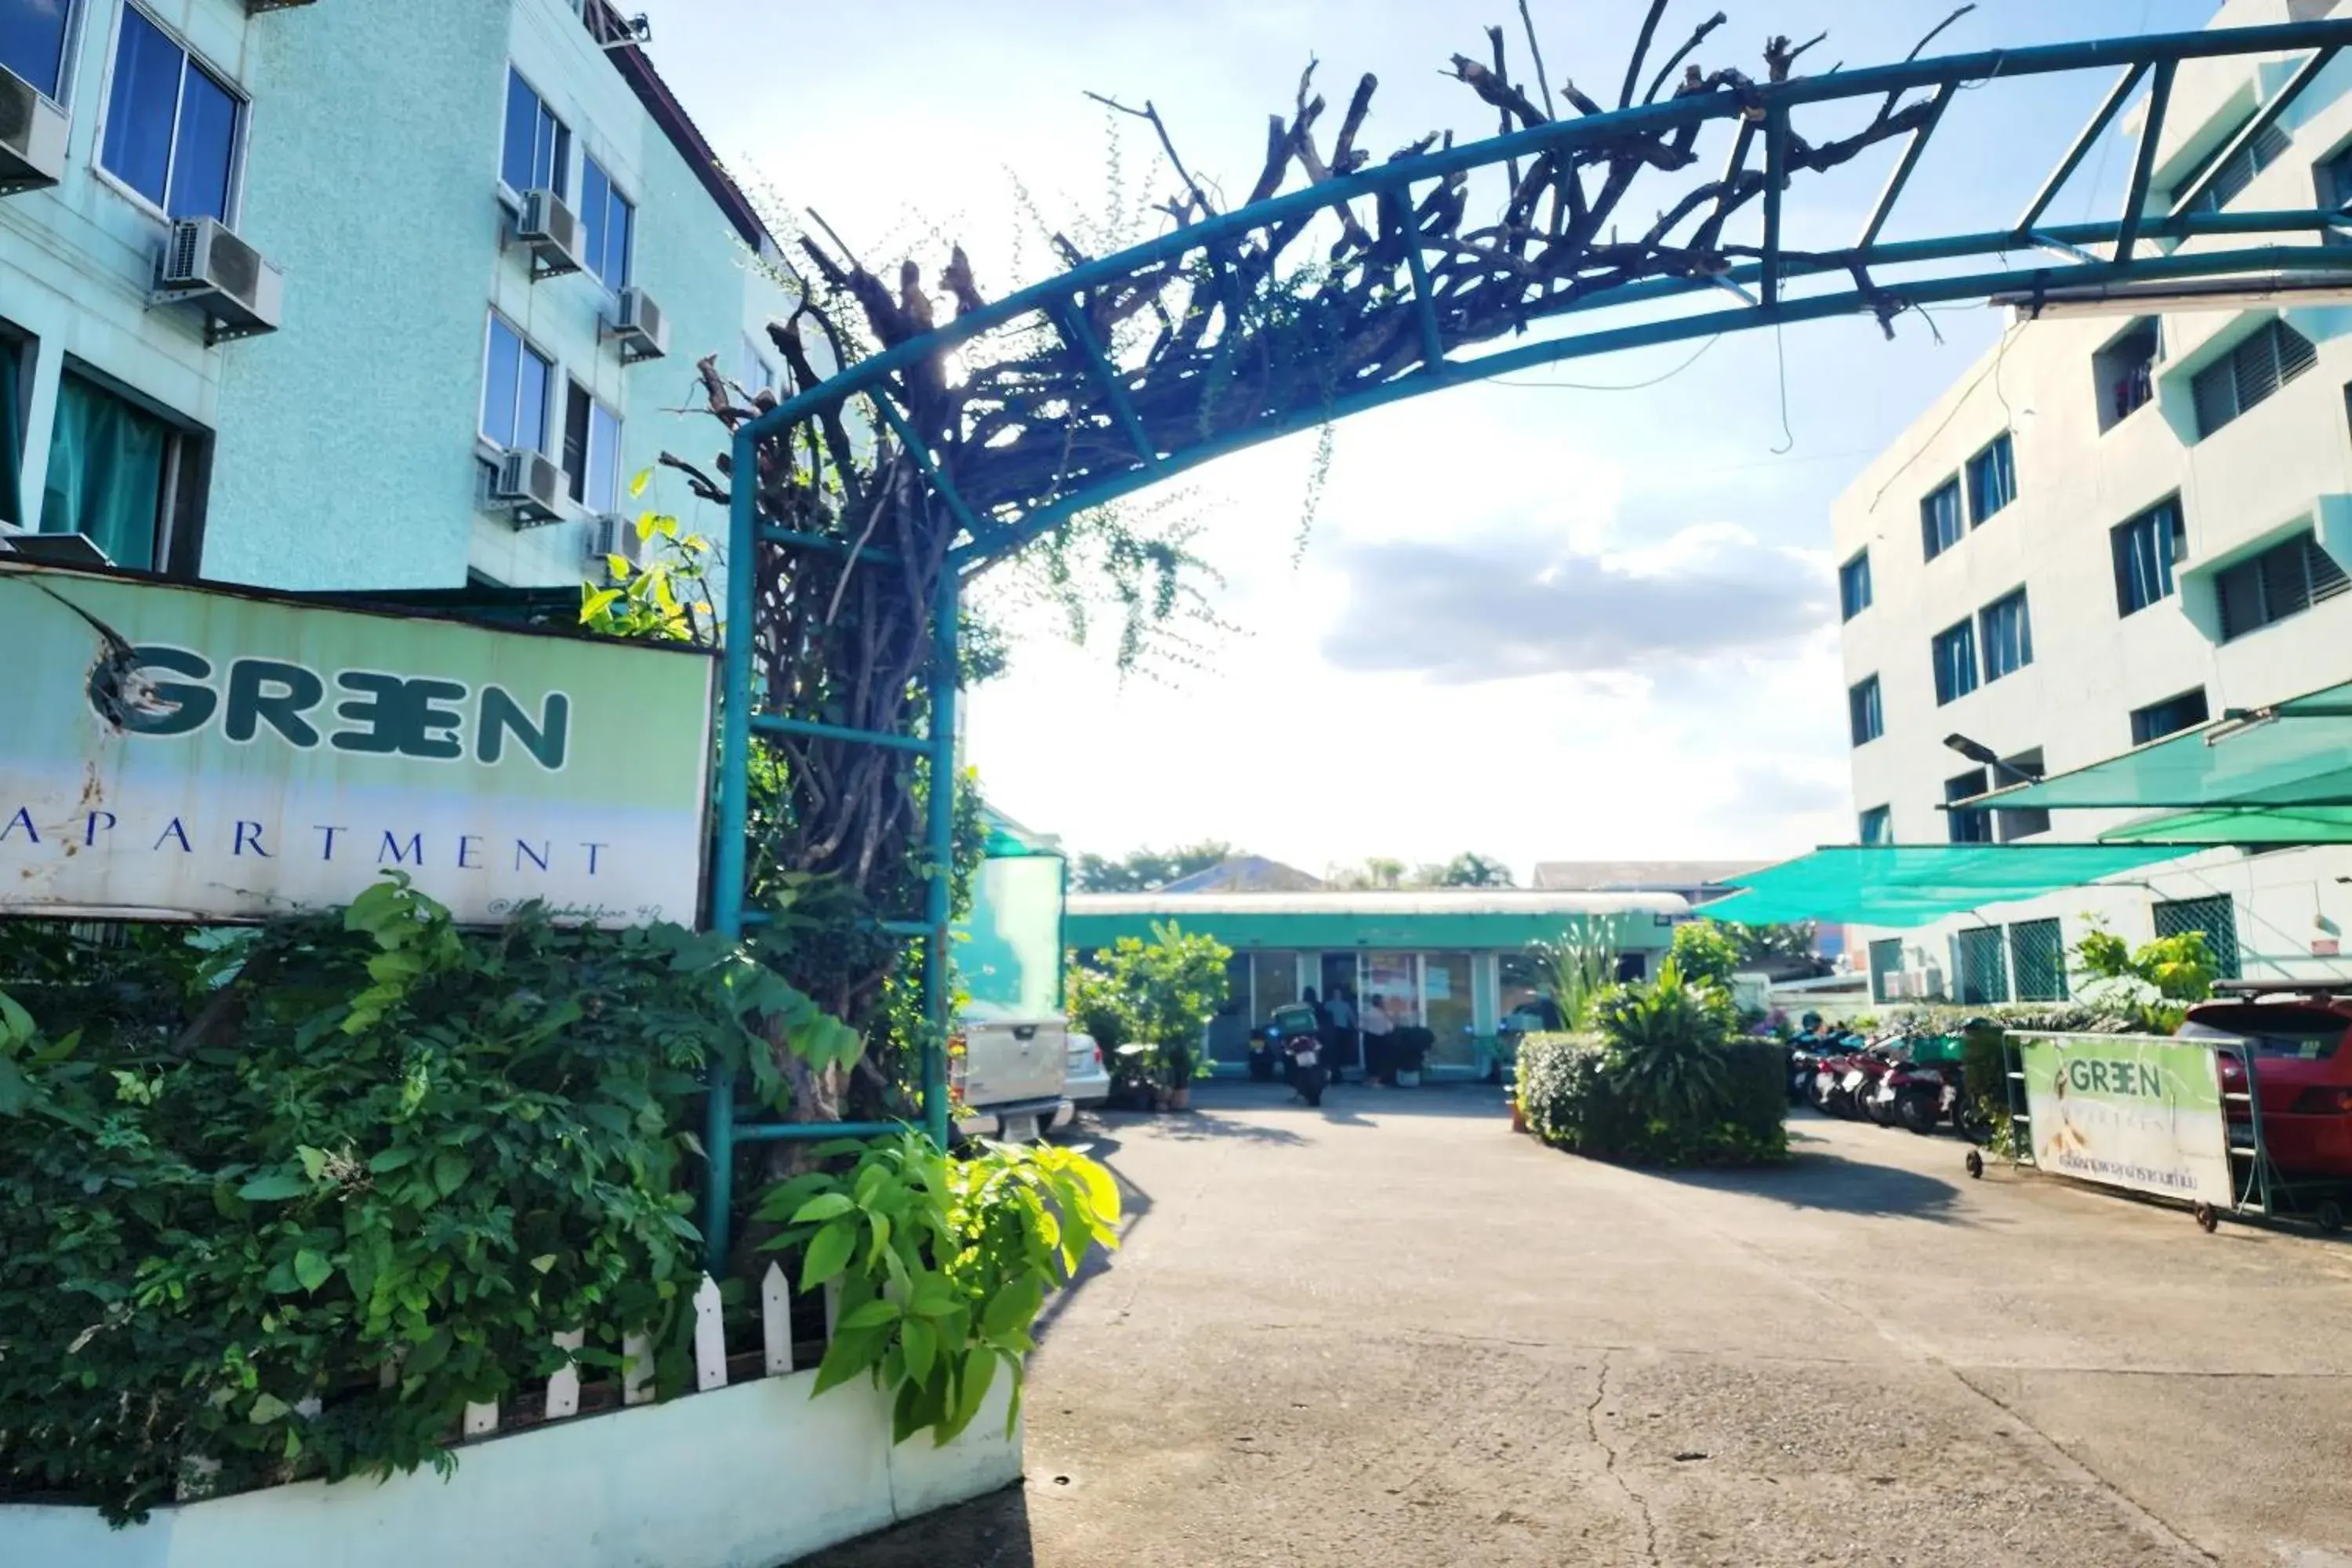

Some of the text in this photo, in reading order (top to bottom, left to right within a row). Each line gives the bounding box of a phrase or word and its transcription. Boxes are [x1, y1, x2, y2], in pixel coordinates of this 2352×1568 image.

[89, 644, 569, 771] GREEN
[0, 806, 609, 875] APARTMENT
[2070, 1059, 2161, 1098] GREEN
